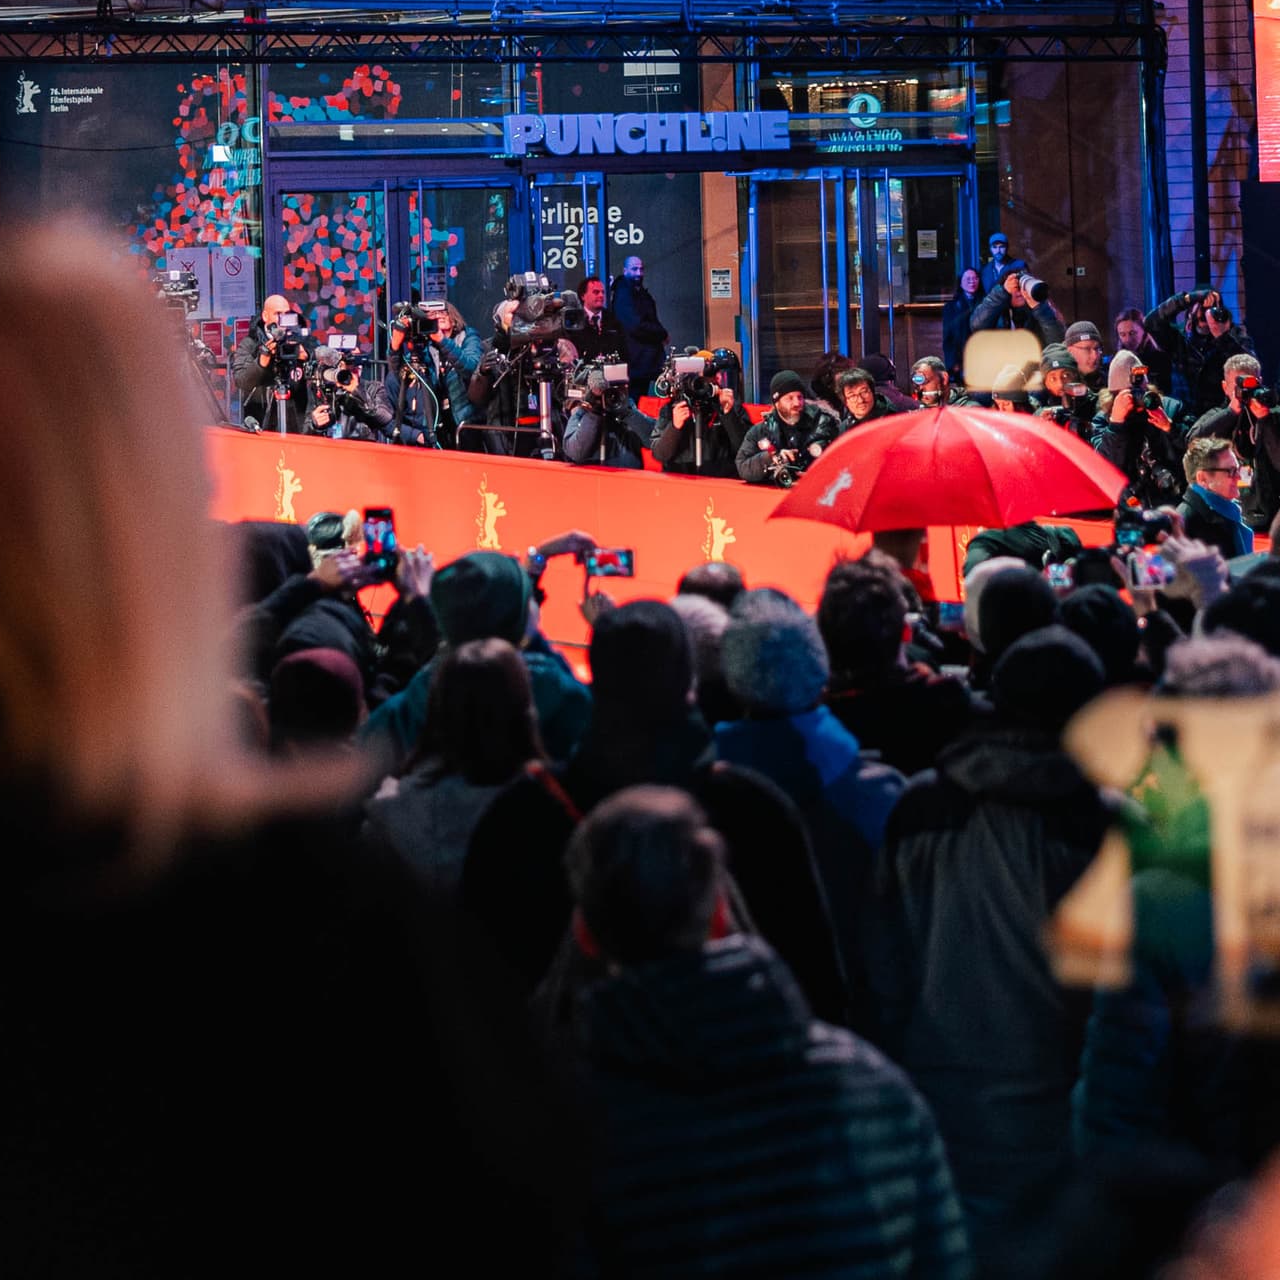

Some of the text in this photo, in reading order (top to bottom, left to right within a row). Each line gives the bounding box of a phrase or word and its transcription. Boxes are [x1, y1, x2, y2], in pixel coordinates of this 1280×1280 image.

[61, 86, 104, 96] Internationale
[50, 96, 93, 105] Filmfestspiele
[50, 104, 69, 113] Berlin
